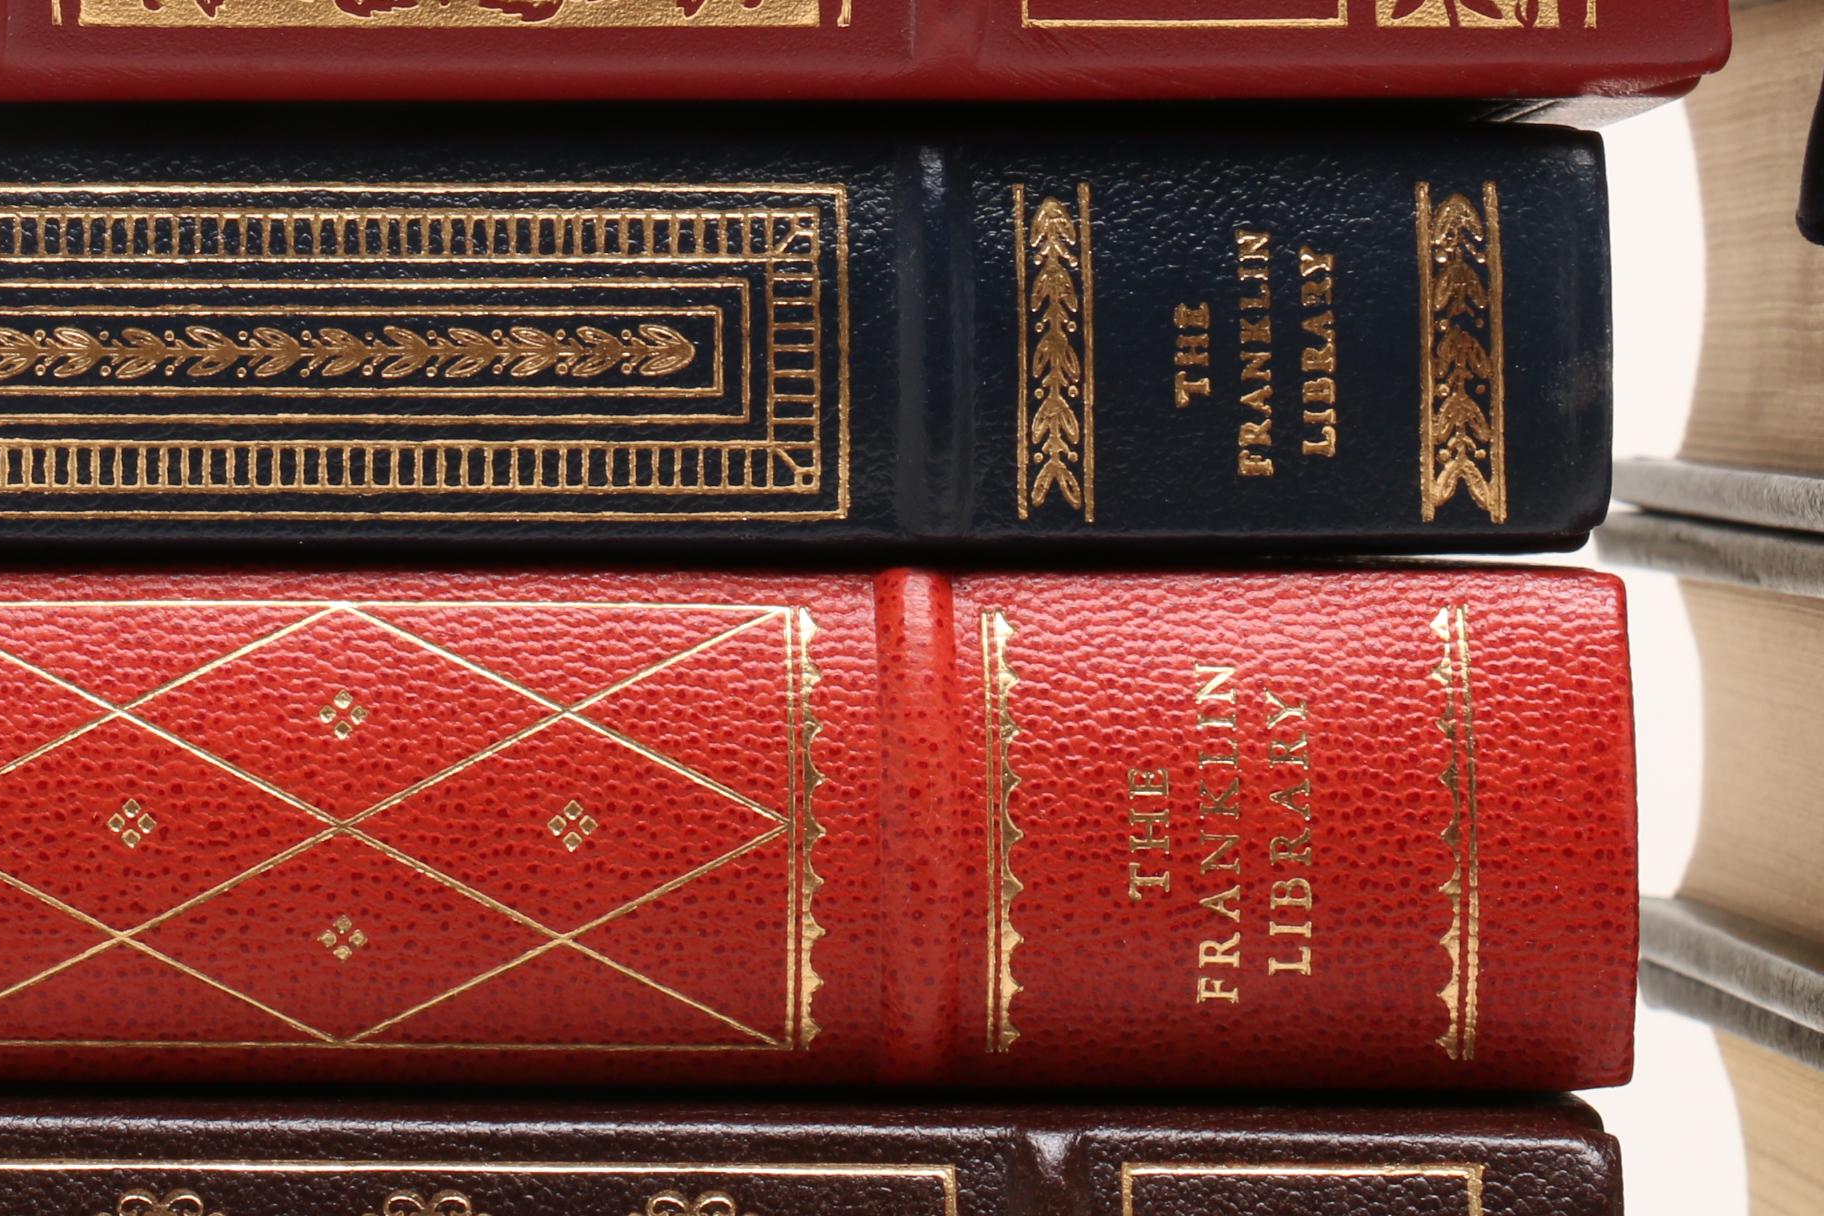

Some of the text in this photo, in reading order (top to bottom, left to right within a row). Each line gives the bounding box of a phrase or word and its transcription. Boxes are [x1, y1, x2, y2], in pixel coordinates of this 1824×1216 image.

[1174, 301, 1210, 408] THE
[1234, 229, 1274, 476] FRANKLIN
[1298, 245, 1337, 458] LIBRARY
[1127, 767, 1171, 902] THE
[1192, 661, 1240, 1004] FRANKLIN
[1263, 687, 1312, 976] LIBRARY
